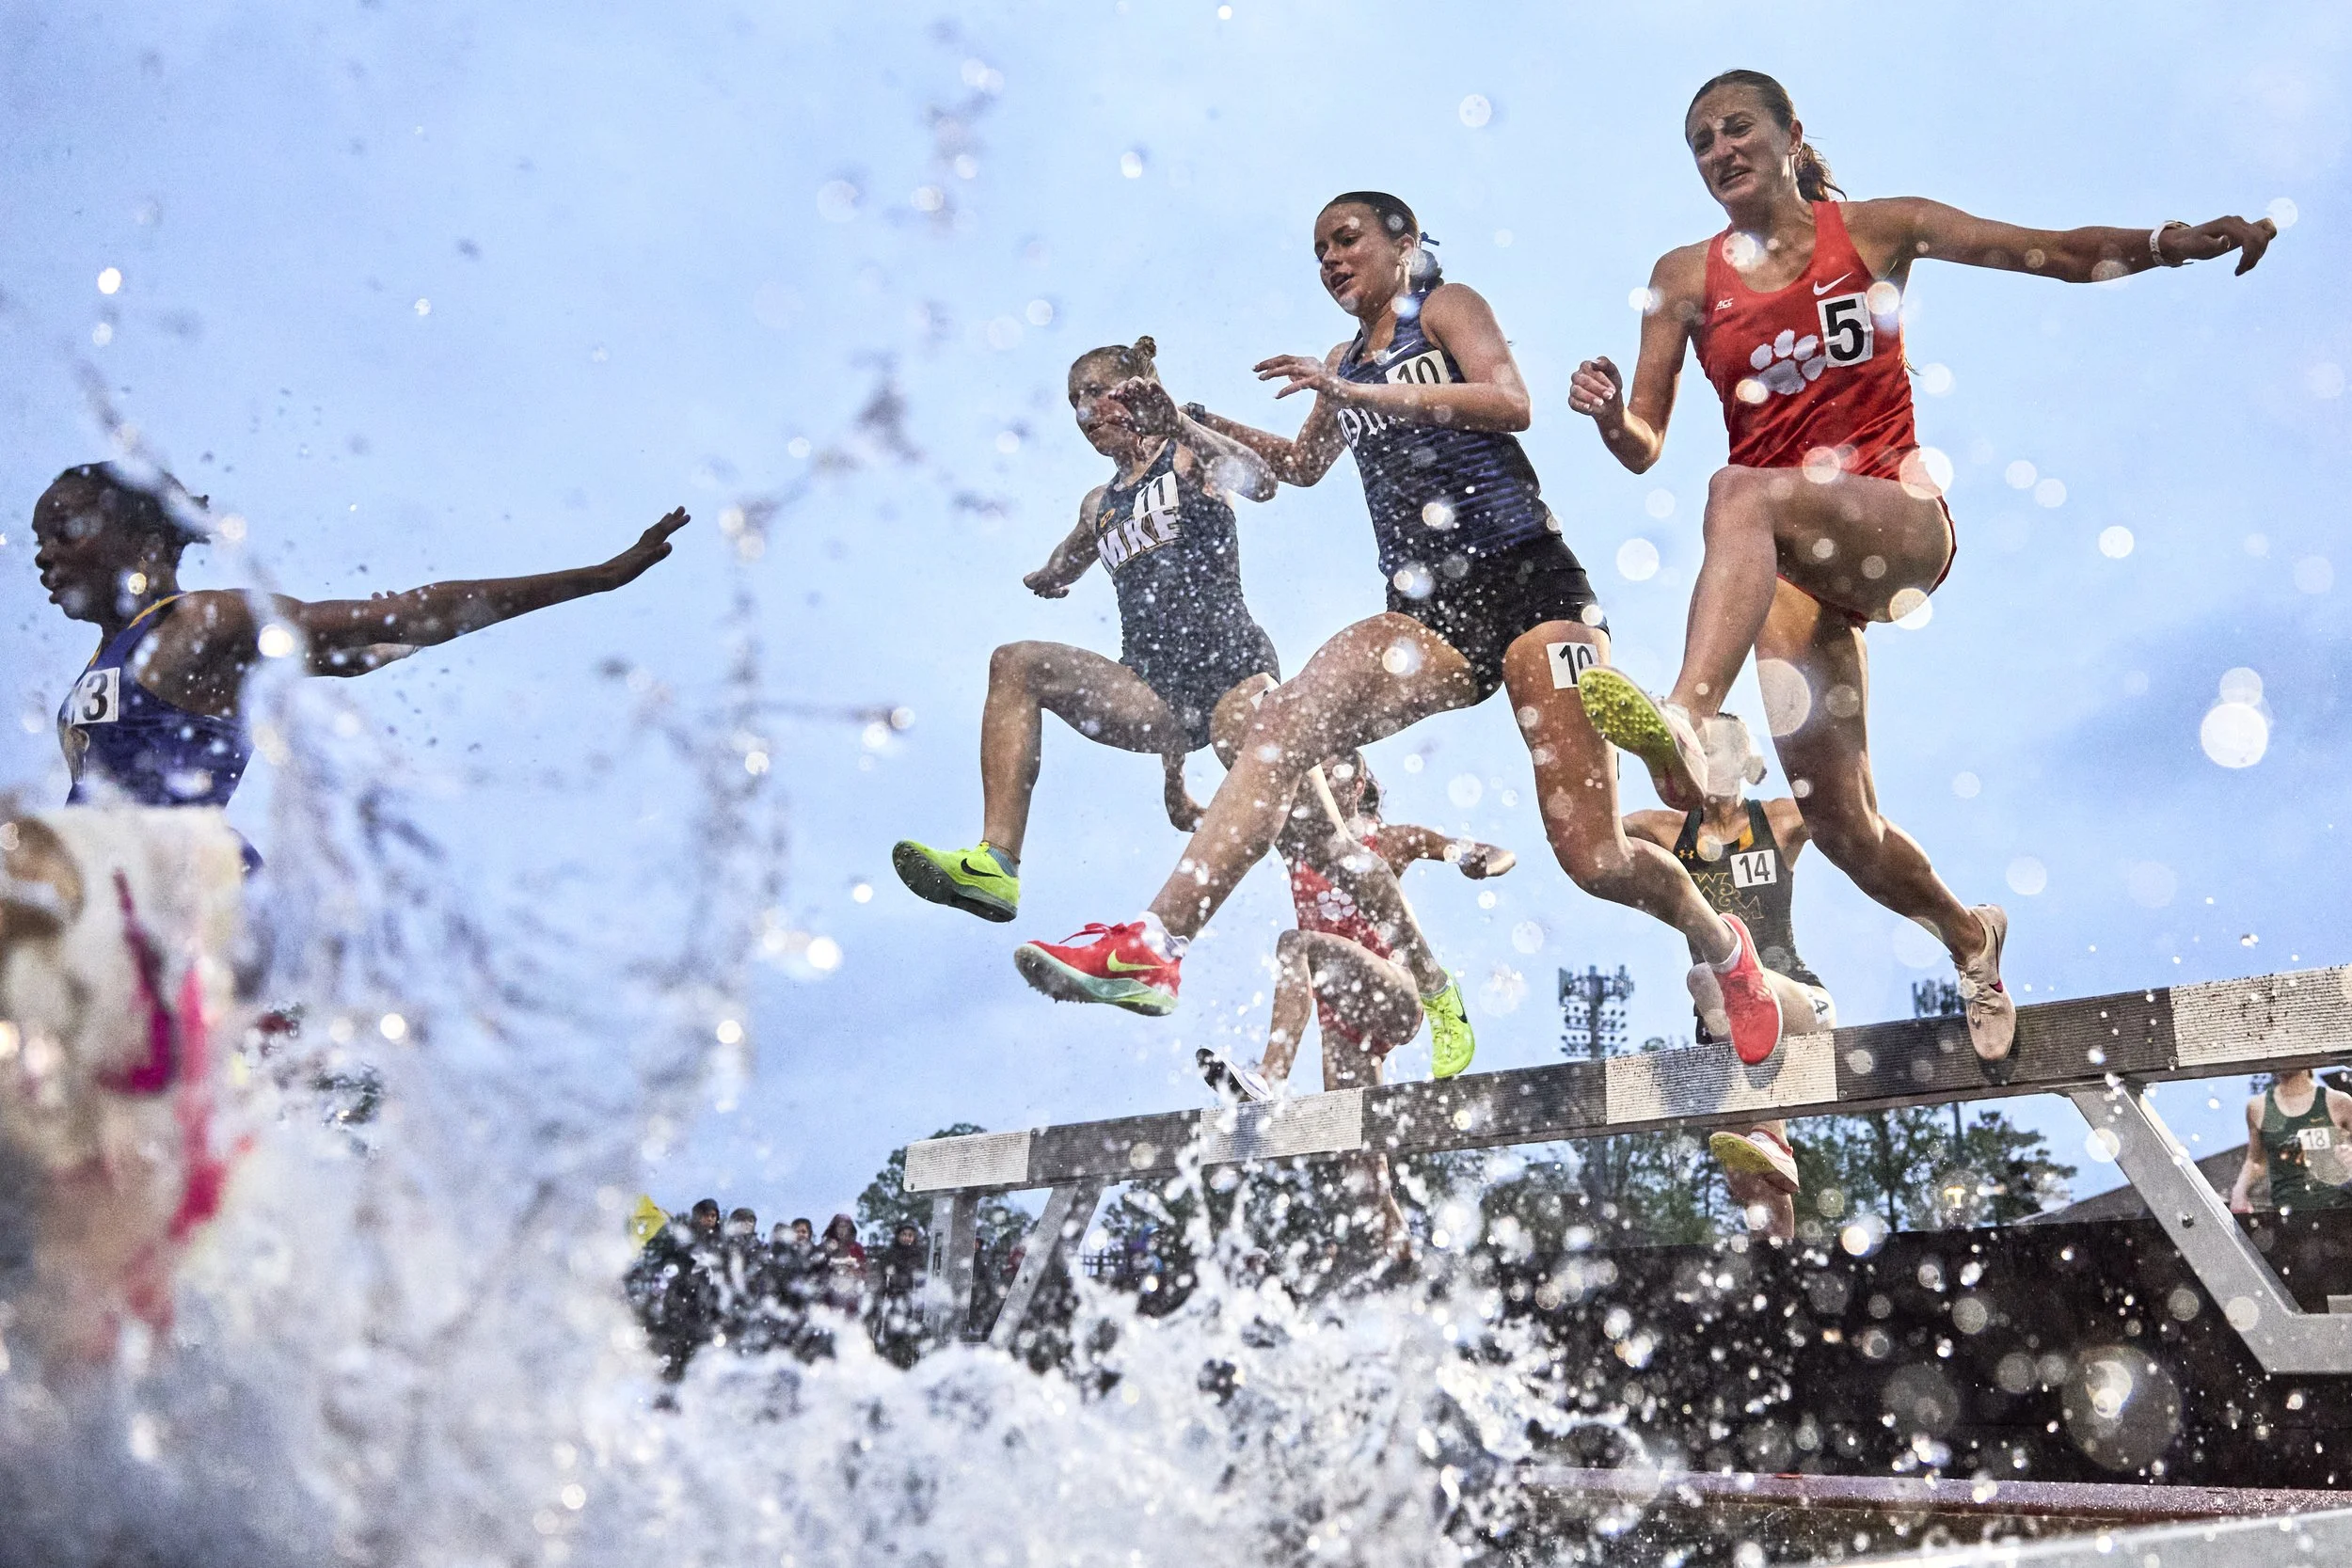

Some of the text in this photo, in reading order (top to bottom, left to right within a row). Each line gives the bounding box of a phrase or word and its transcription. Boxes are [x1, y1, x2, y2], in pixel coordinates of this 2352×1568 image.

[1716, 298, 1734, 310] ACC
[1825, 298, 1865, 361] 5
[1141, 478, 1166, 514] 11
[1097, 506, 1183, 575] MKE
[1559, 644, 1594, 685] 10
[1739, 852, 1771, 884] 14
[2305, 1130, 2325, 1148] 18
